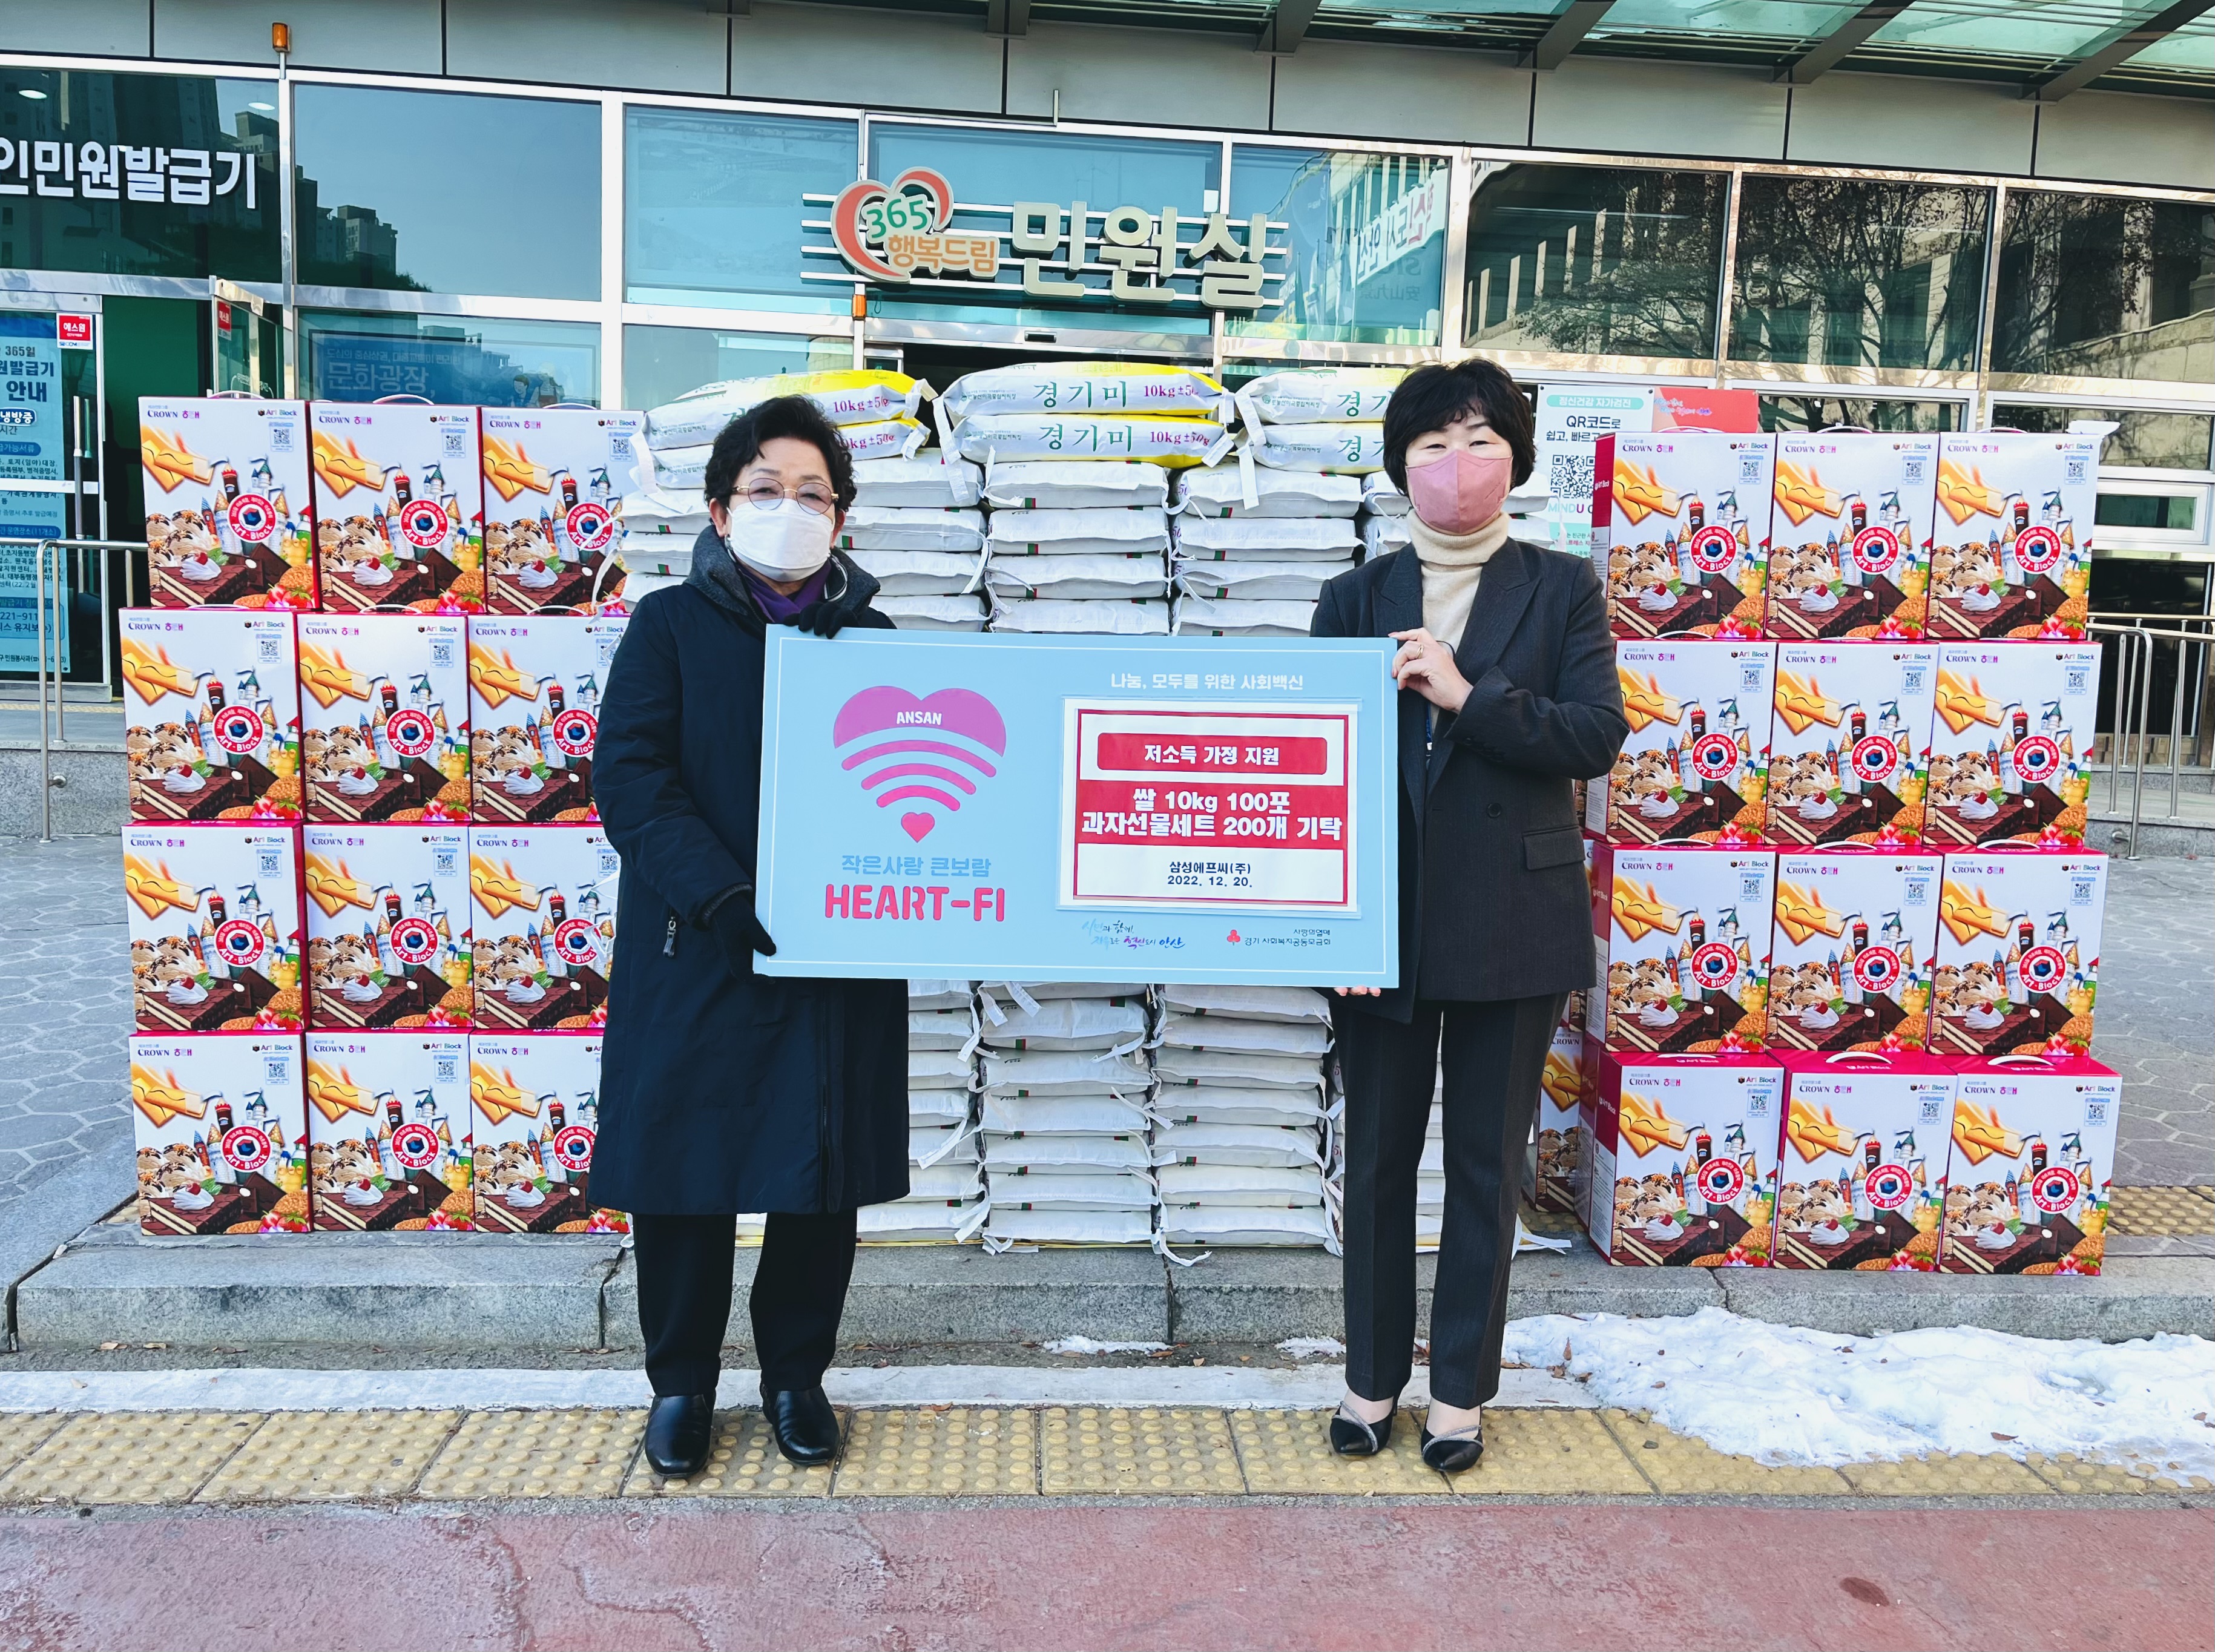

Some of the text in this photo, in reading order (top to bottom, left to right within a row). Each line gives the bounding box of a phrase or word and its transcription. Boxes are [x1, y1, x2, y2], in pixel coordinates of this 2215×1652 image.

[866, 194, 929, 238] 365
[888, 234, 997, 274] 행복드림
[1012, 201, 1265, 309] 민원실
[63, 322, 86, 332] 에스원
[5, 346, 35, 357] 365일
[328, 361, 435, 398] 문화광장,
[6, 381, 47, 402] 안내
[1033, 381, 1175, 408] 경기미 10kg
[833, 400, 865, 413] 10kg
[1559, 397, 1631, 408] 정신건강 자가검진
[146, 410, 177, 418] CROWN
[1567, 415, 1621, 430] QR코드로
[1039, 423, 1131, 452] 경기미
[1150, 432, 1181, 445] 10kg
[1546, 430, 1568, 442] 쉽고,
[1111, 673, 1303, 691] 나눔, 모두를 위한 사회백신
[896, 711, 943, 725] ANSAN
[1144, 745, 1279, 766] 저소득 가정 지원
[1133, 789, 1291, 815] 쌀 10kg 100포
[1082, 812, 1343, 841] 과자선물세트 200개 기탁
[841, 855, 992, 877] 작은사랑 큰보람
[1169, 861, 1251, 876] 삼성에프씨(주)
[1168, 875, 1252, 888] 2022. 12. 20.
[825, 883, 1005, 922] HEART-FI
[1082, 918, 1111, 935] 시민과
[1124, 936, 1156, 950] 혁신도시
[1159, 936, 1185, 949] 안산
[1245, 937, 1331, 947] 경기 사회복지공동모금회
